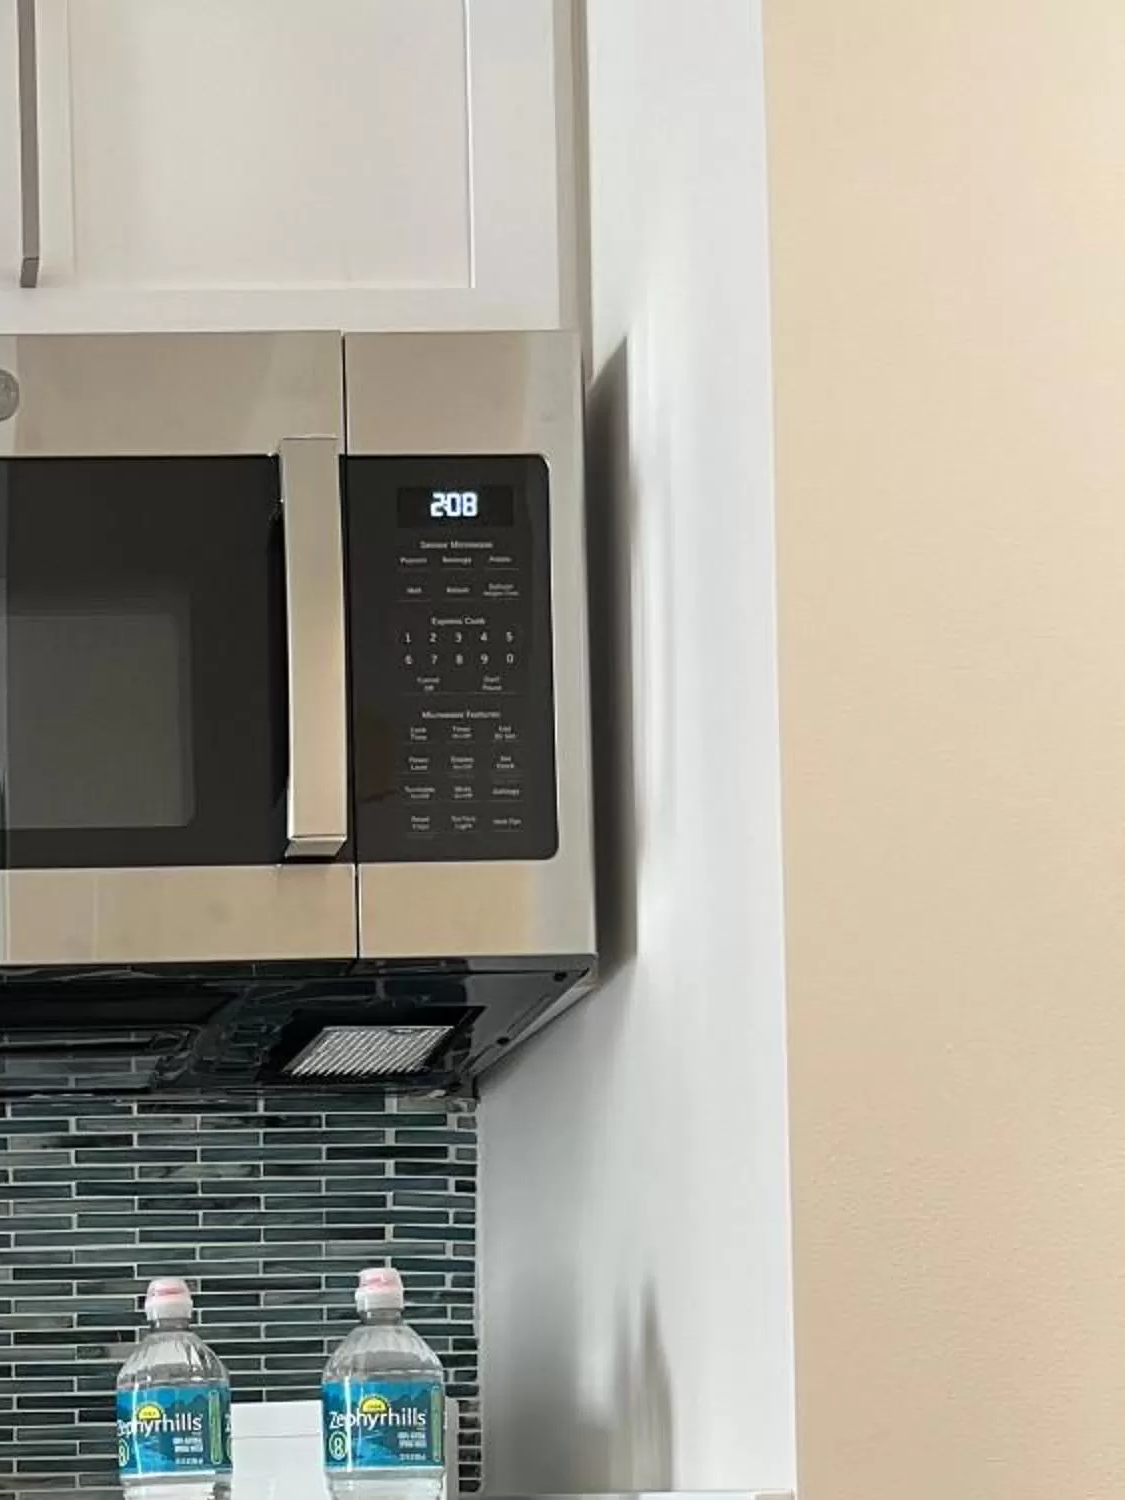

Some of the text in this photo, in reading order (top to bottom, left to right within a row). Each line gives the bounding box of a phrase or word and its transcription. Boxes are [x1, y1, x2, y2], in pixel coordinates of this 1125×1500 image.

[404, 632, 412, 643] 1
[428, 632, 438, 643] 2
[479, 631, 488, 642] 4
[505, 631, 514, 642] 5
[430, 654, 439, 665] 7
[480, 653, 489, 665] 9
[506, 653, 514, 665] 0
[328, 1407, 427, 1431] Zephyrhills
